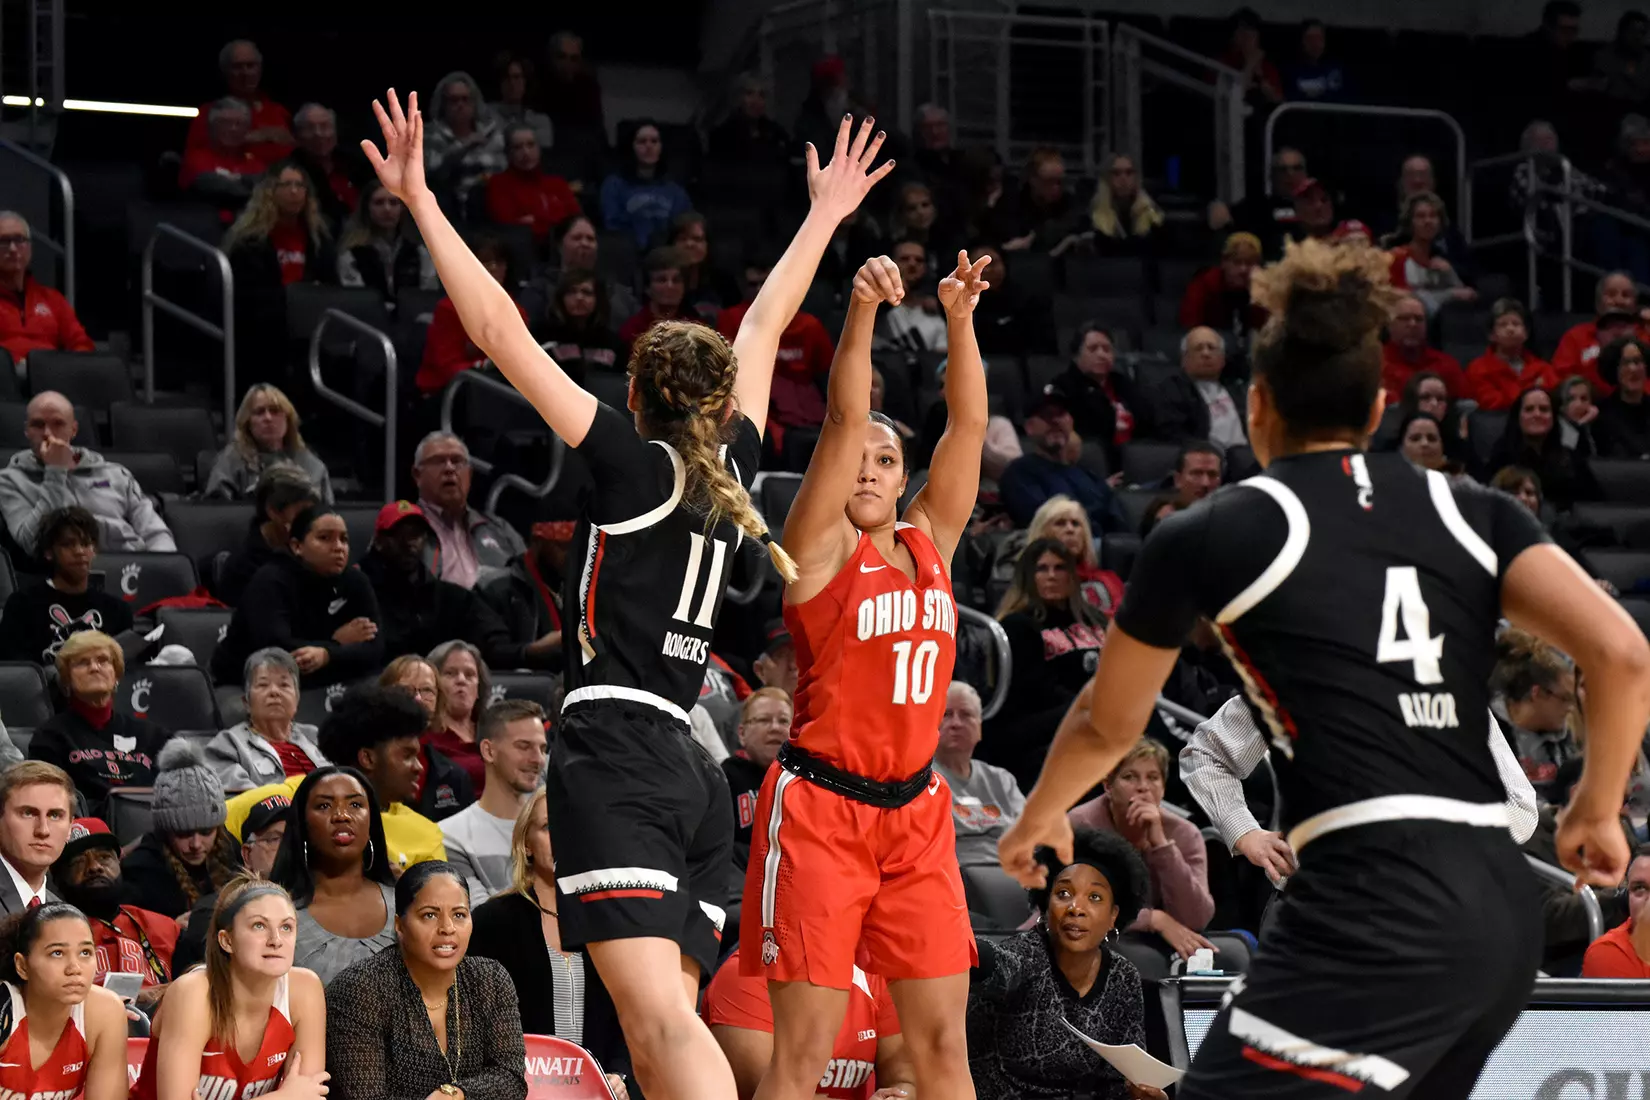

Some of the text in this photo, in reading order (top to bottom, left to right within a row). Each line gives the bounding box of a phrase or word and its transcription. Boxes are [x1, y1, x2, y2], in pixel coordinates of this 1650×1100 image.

[672, 531, 727, 629] 11
[857, 589, 917, 641] OHIO
[1376, 566, 1445, 685] 4
[662, 631, 709, 665] RODGERS
[892, 640, 940, 704] 10
[1397, 692, 1460, 729] RIZOR
[261, 795, 291, 811] TH
[524, 1056, 584, 1076] NNATI
[199, 1074, 238, 1100] HIO
